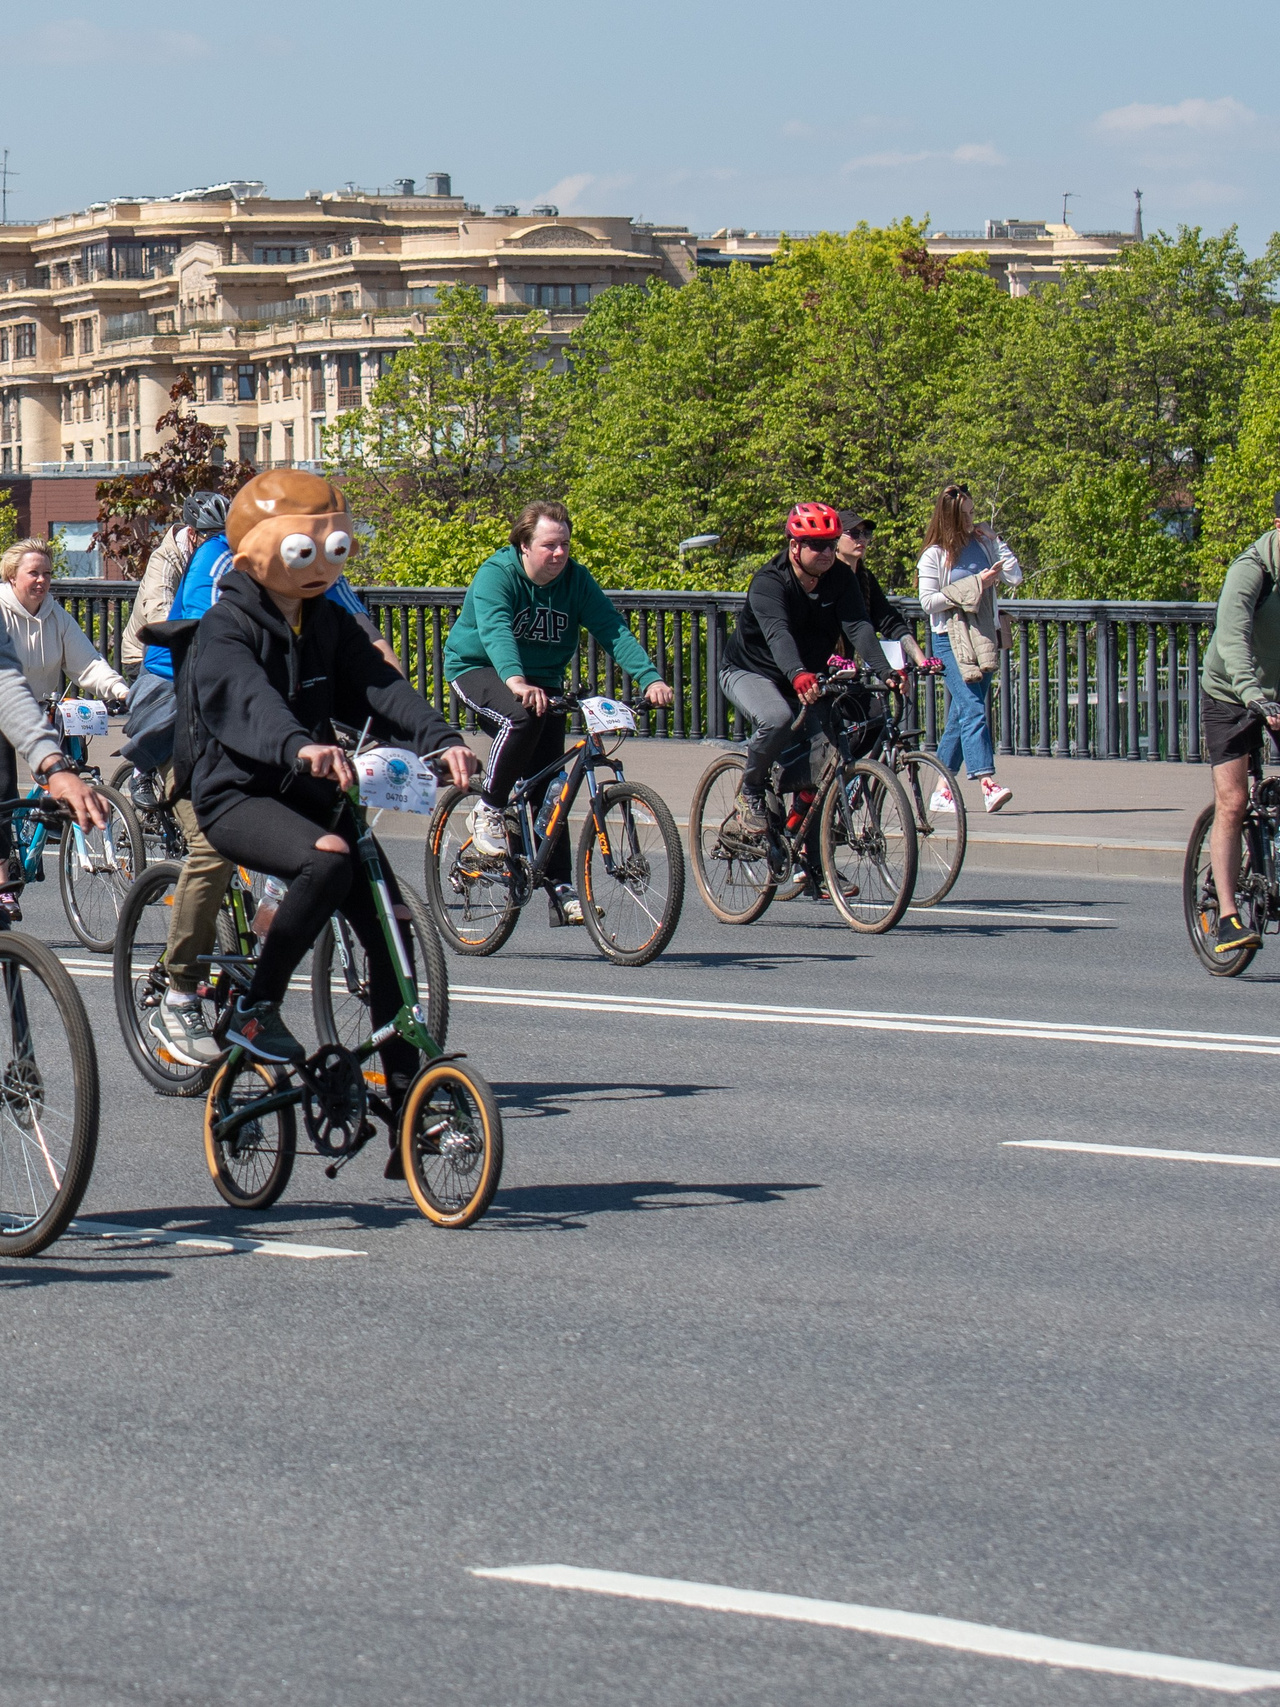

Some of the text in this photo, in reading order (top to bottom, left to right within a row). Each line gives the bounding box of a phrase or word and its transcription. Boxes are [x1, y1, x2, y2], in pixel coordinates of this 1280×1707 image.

[513, 606, 569, 643] GAP
[385, 792, 408, 803] 04703
[597, 832, 610, 855] XCM
